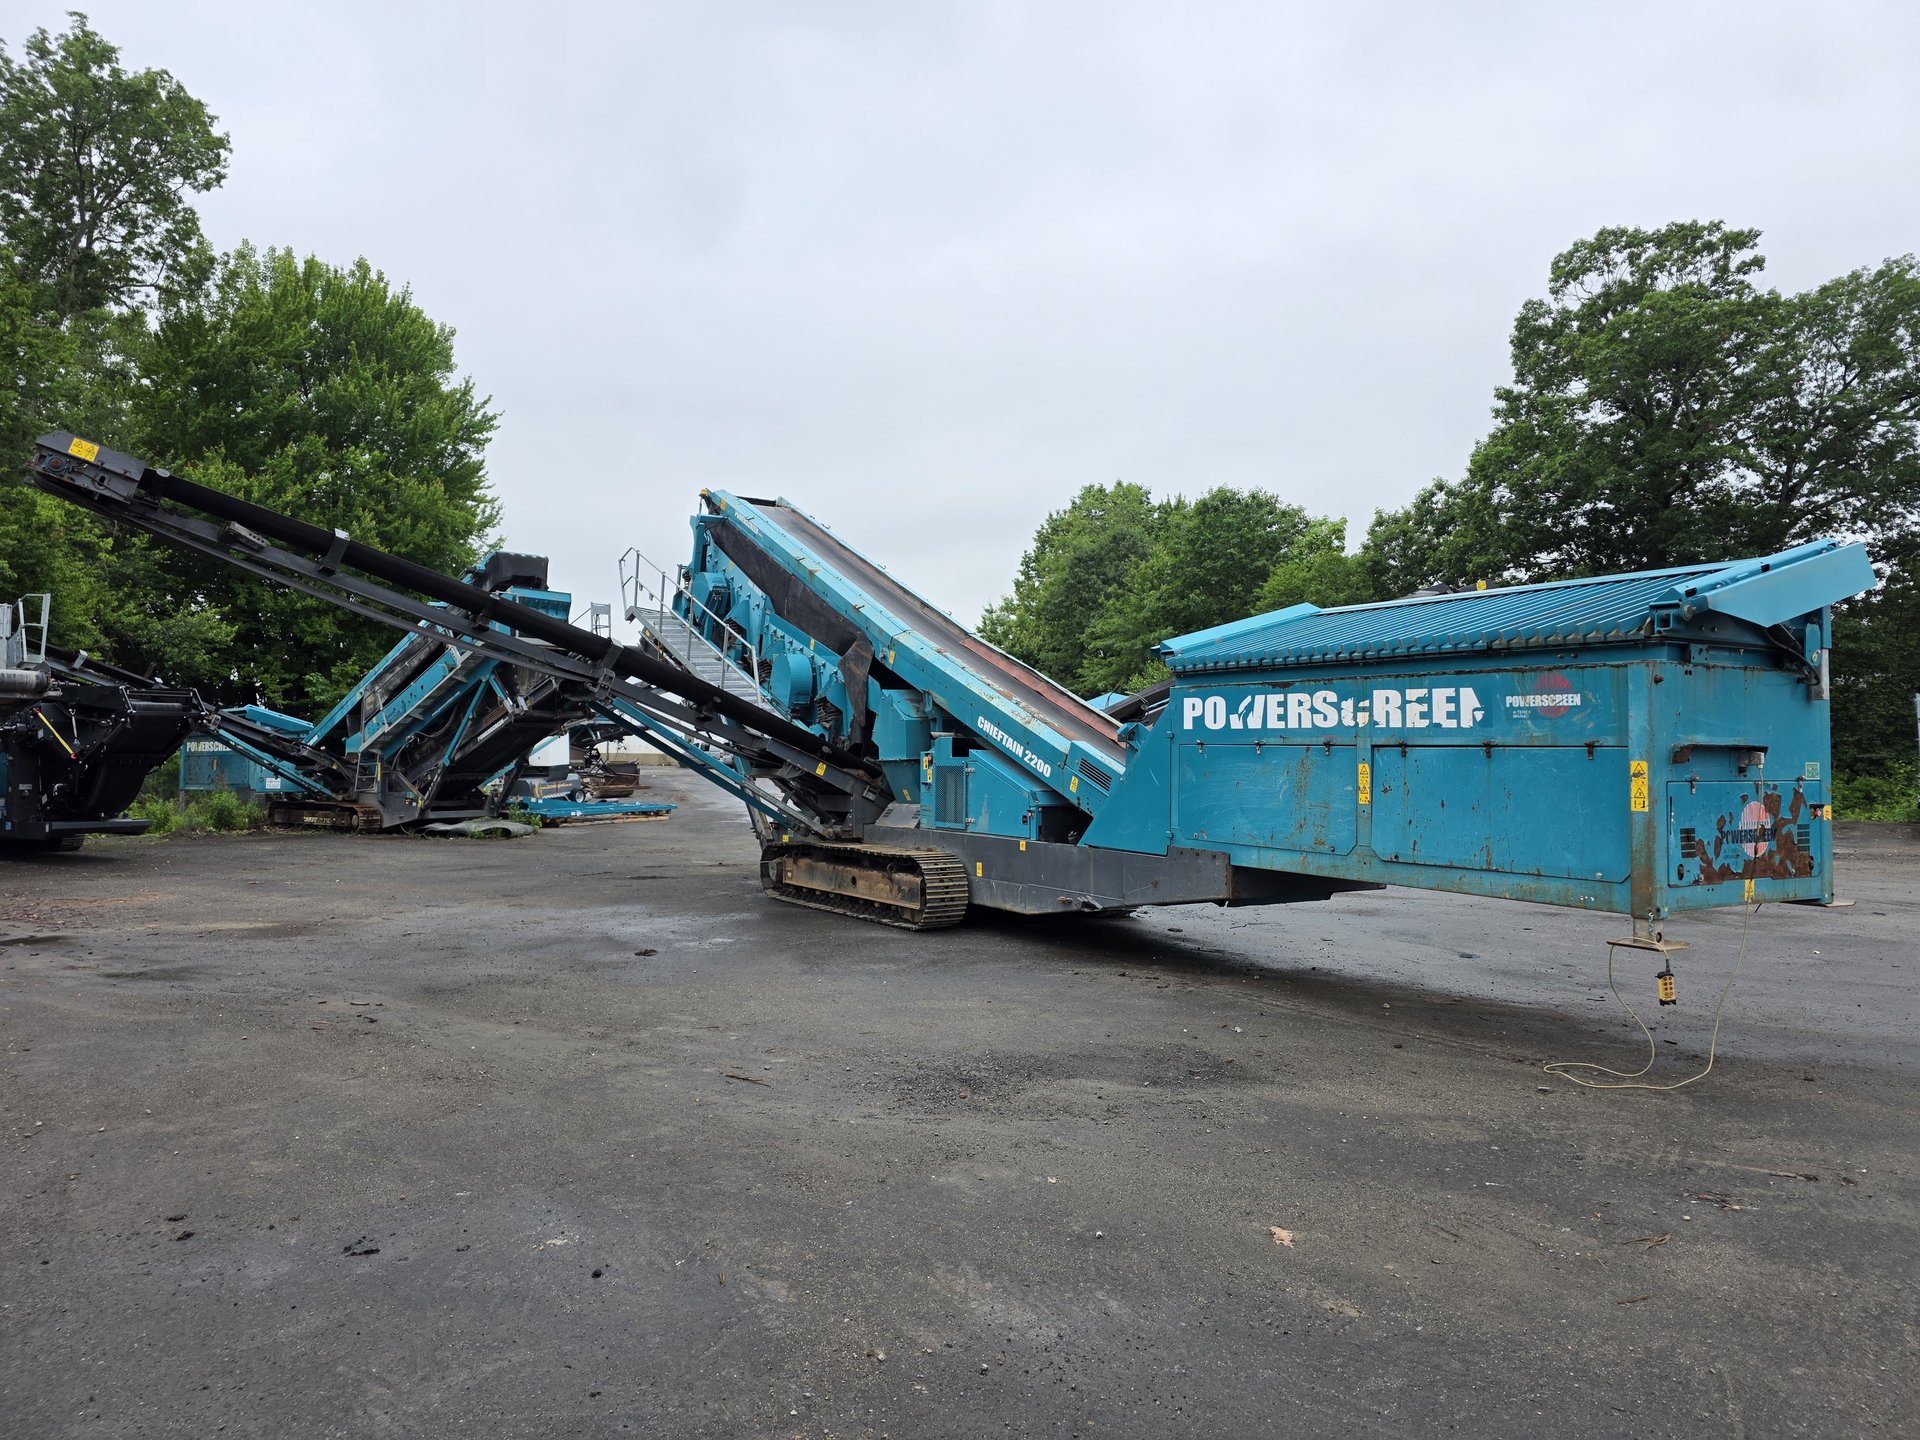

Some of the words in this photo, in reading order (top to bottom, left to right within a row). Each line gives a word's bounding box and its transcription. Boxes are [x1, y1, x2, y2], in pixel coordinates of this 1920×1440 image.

[1505, 693, 1581, 708] POWERSCREEN
[977, 715, 1024, 758] CHIEFTAIN
[1023, 749, 1051, 778] 2200
